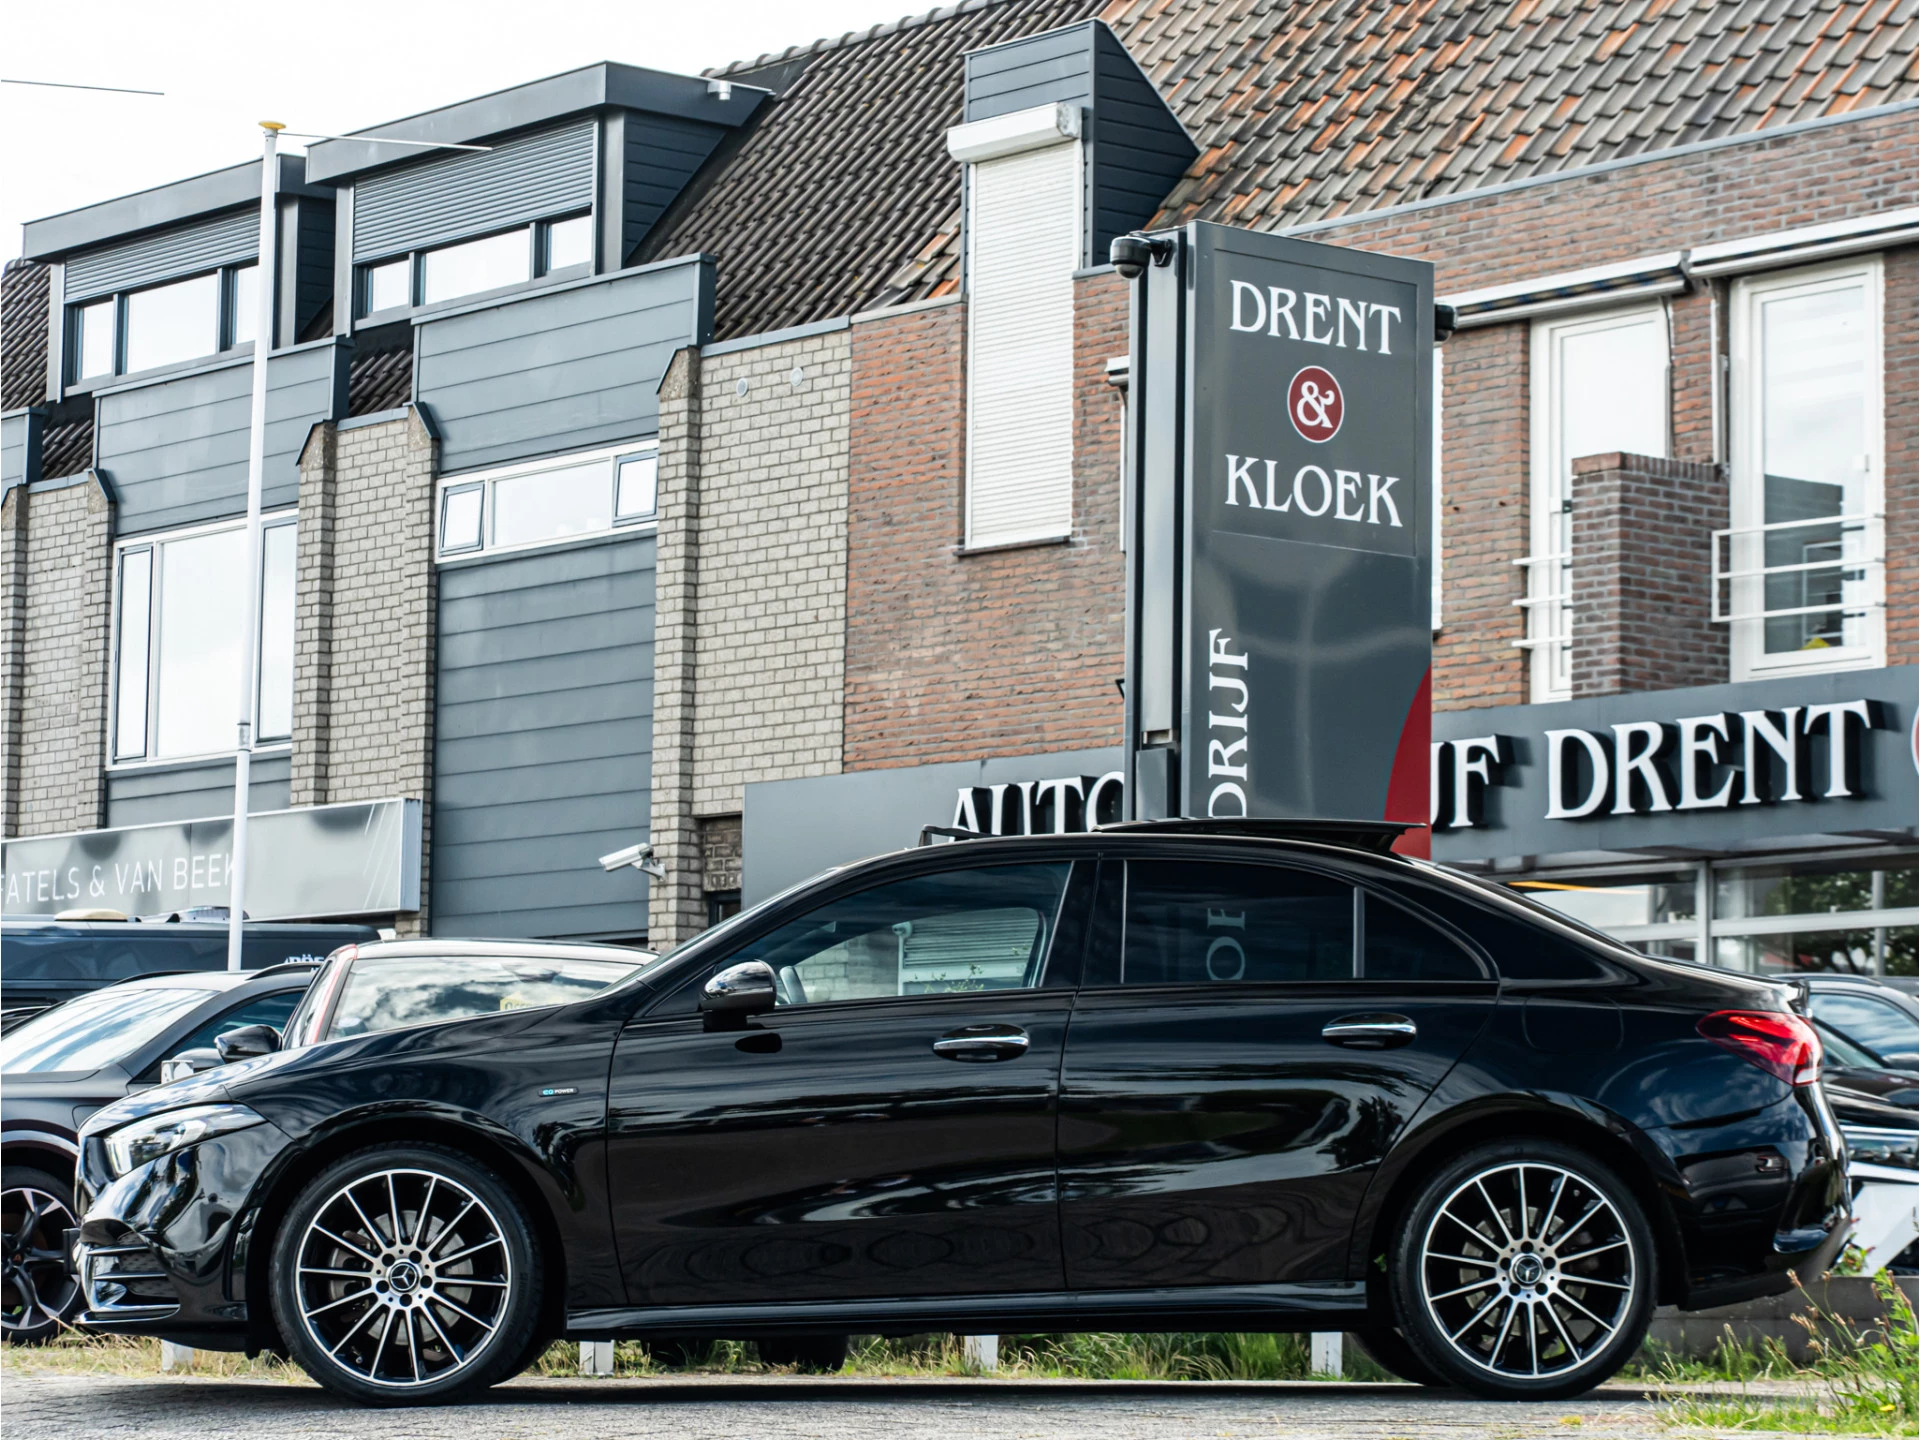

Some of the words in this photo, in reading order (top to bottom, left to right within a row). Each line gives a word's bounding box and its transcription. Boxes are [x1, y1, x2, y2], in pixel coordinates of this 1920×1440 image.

[1229, 279, 1402, 355] DRENT
[1296, 380, 1335, 429] &
[1224, 453, 1403, 528] KLOEK
[1545, 699, 1871, 820] DRENT
[89, 864, 105, 898] &
[115, 858, 162, 895] VAN
[554, 1087, 574, 1095] POWER
